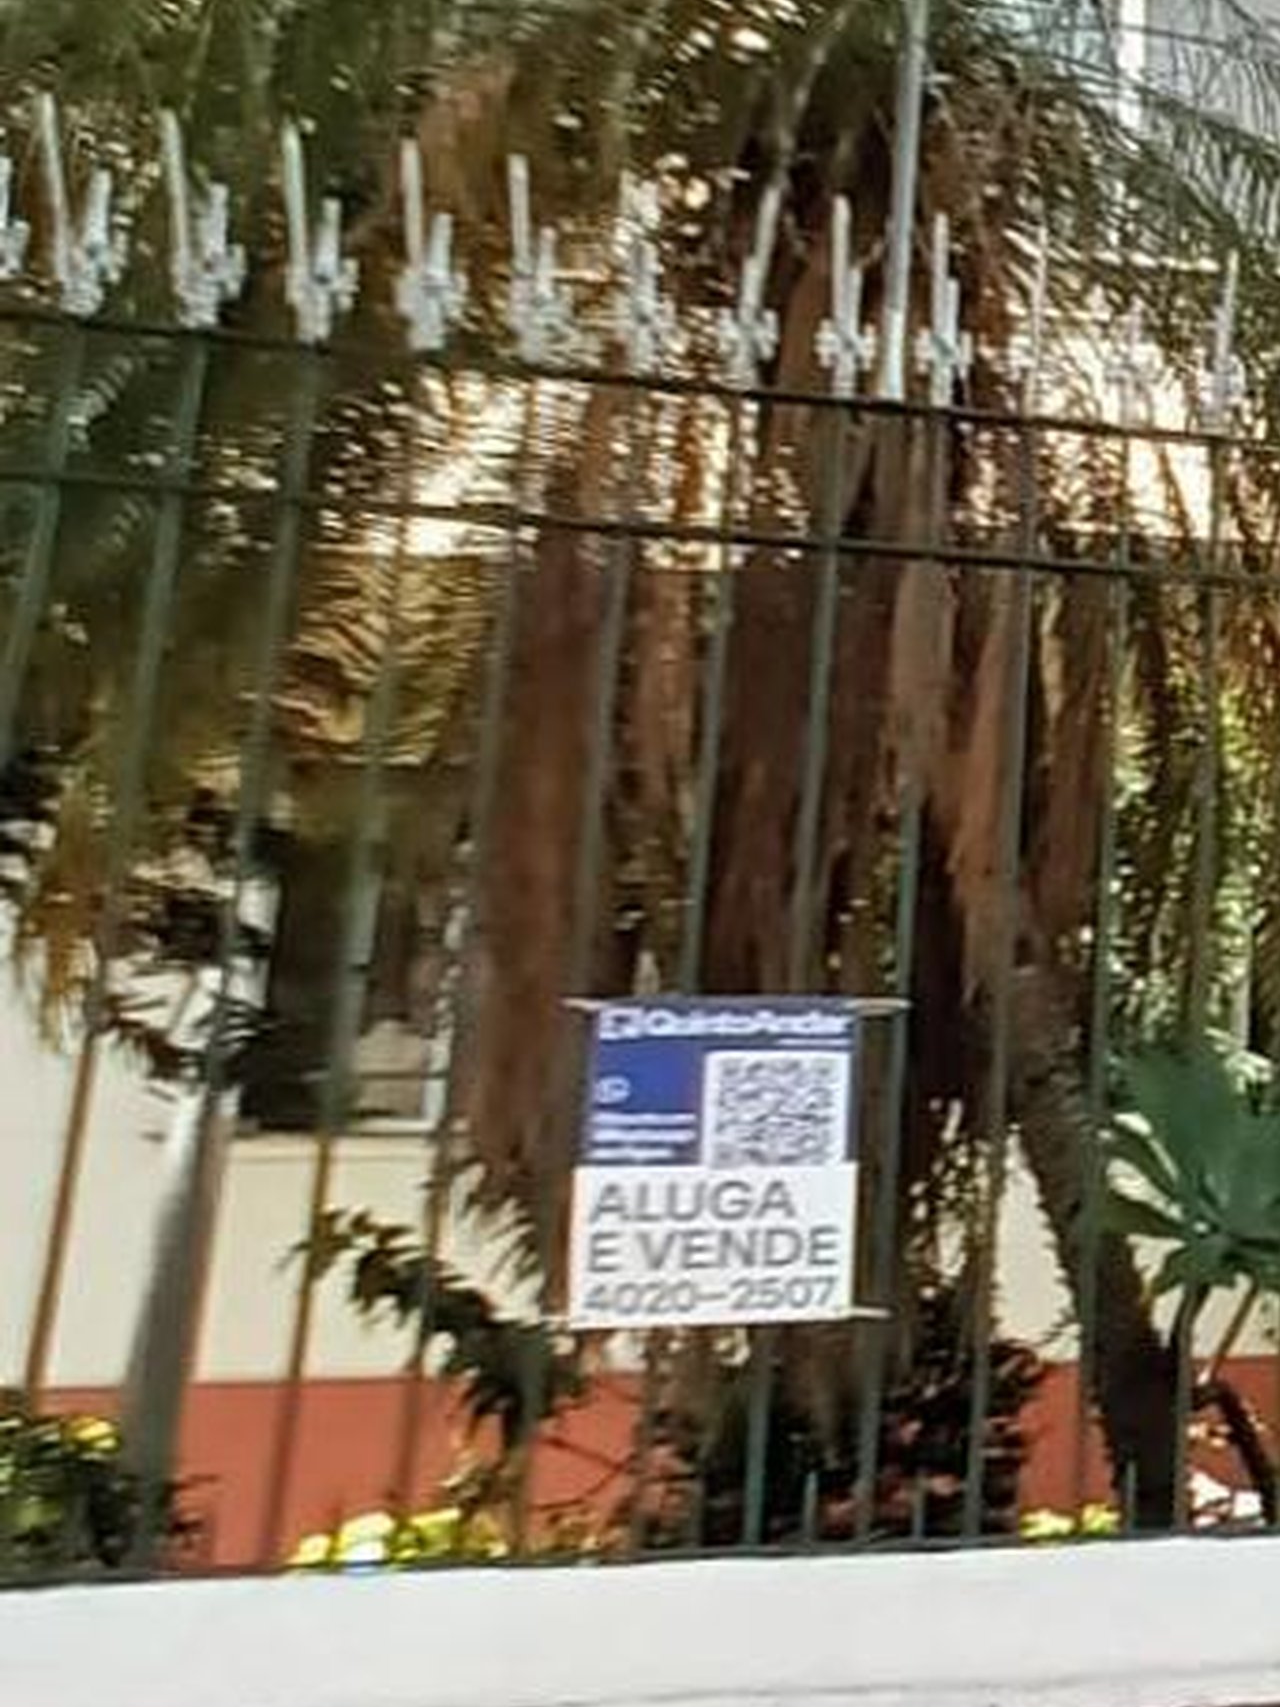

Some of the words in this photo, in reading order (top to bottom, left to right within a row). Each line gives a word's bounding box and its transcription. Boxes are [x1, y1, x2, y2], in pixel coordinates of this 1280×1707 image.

[589, 1179, 797, 1224] ALUGA
[588, 1231, 622, 1273] E
[637, 1225, 840, 1272] VENDE
[582, 1276, 840, 1316] 4020-2507
